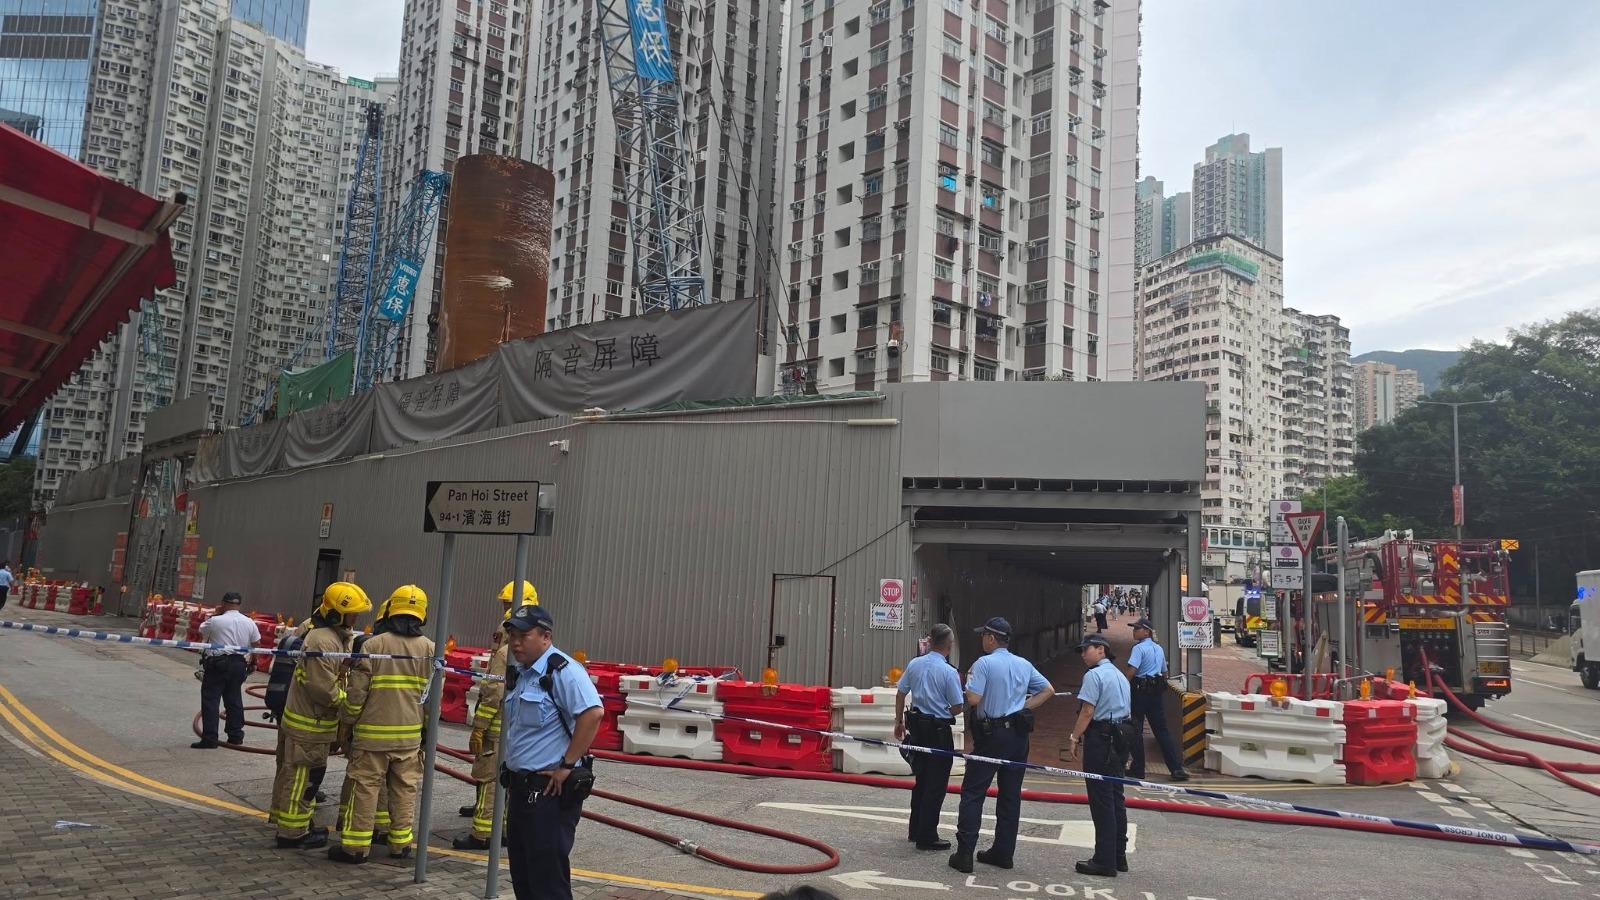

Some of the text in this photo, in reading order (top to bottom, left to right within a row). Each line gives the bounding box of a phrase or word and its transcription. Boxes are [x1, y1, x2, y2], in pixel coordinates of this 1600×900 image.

[385, 274, 411, 315] 惠保
[533, 332, 663, 381] 隔音屏障
[448, 489, 529, 501] Pan Hoi Street
[461, 509, 511, 526] 濱海街
[883, 587, 900, 596] STOP
[1188, 605, 1205, 615] STOP
[1444, 826, 1473, 836] CROSS
[1477, 831, 1494, 840] NOT
[965, 875, 1118, 900] LOOK
